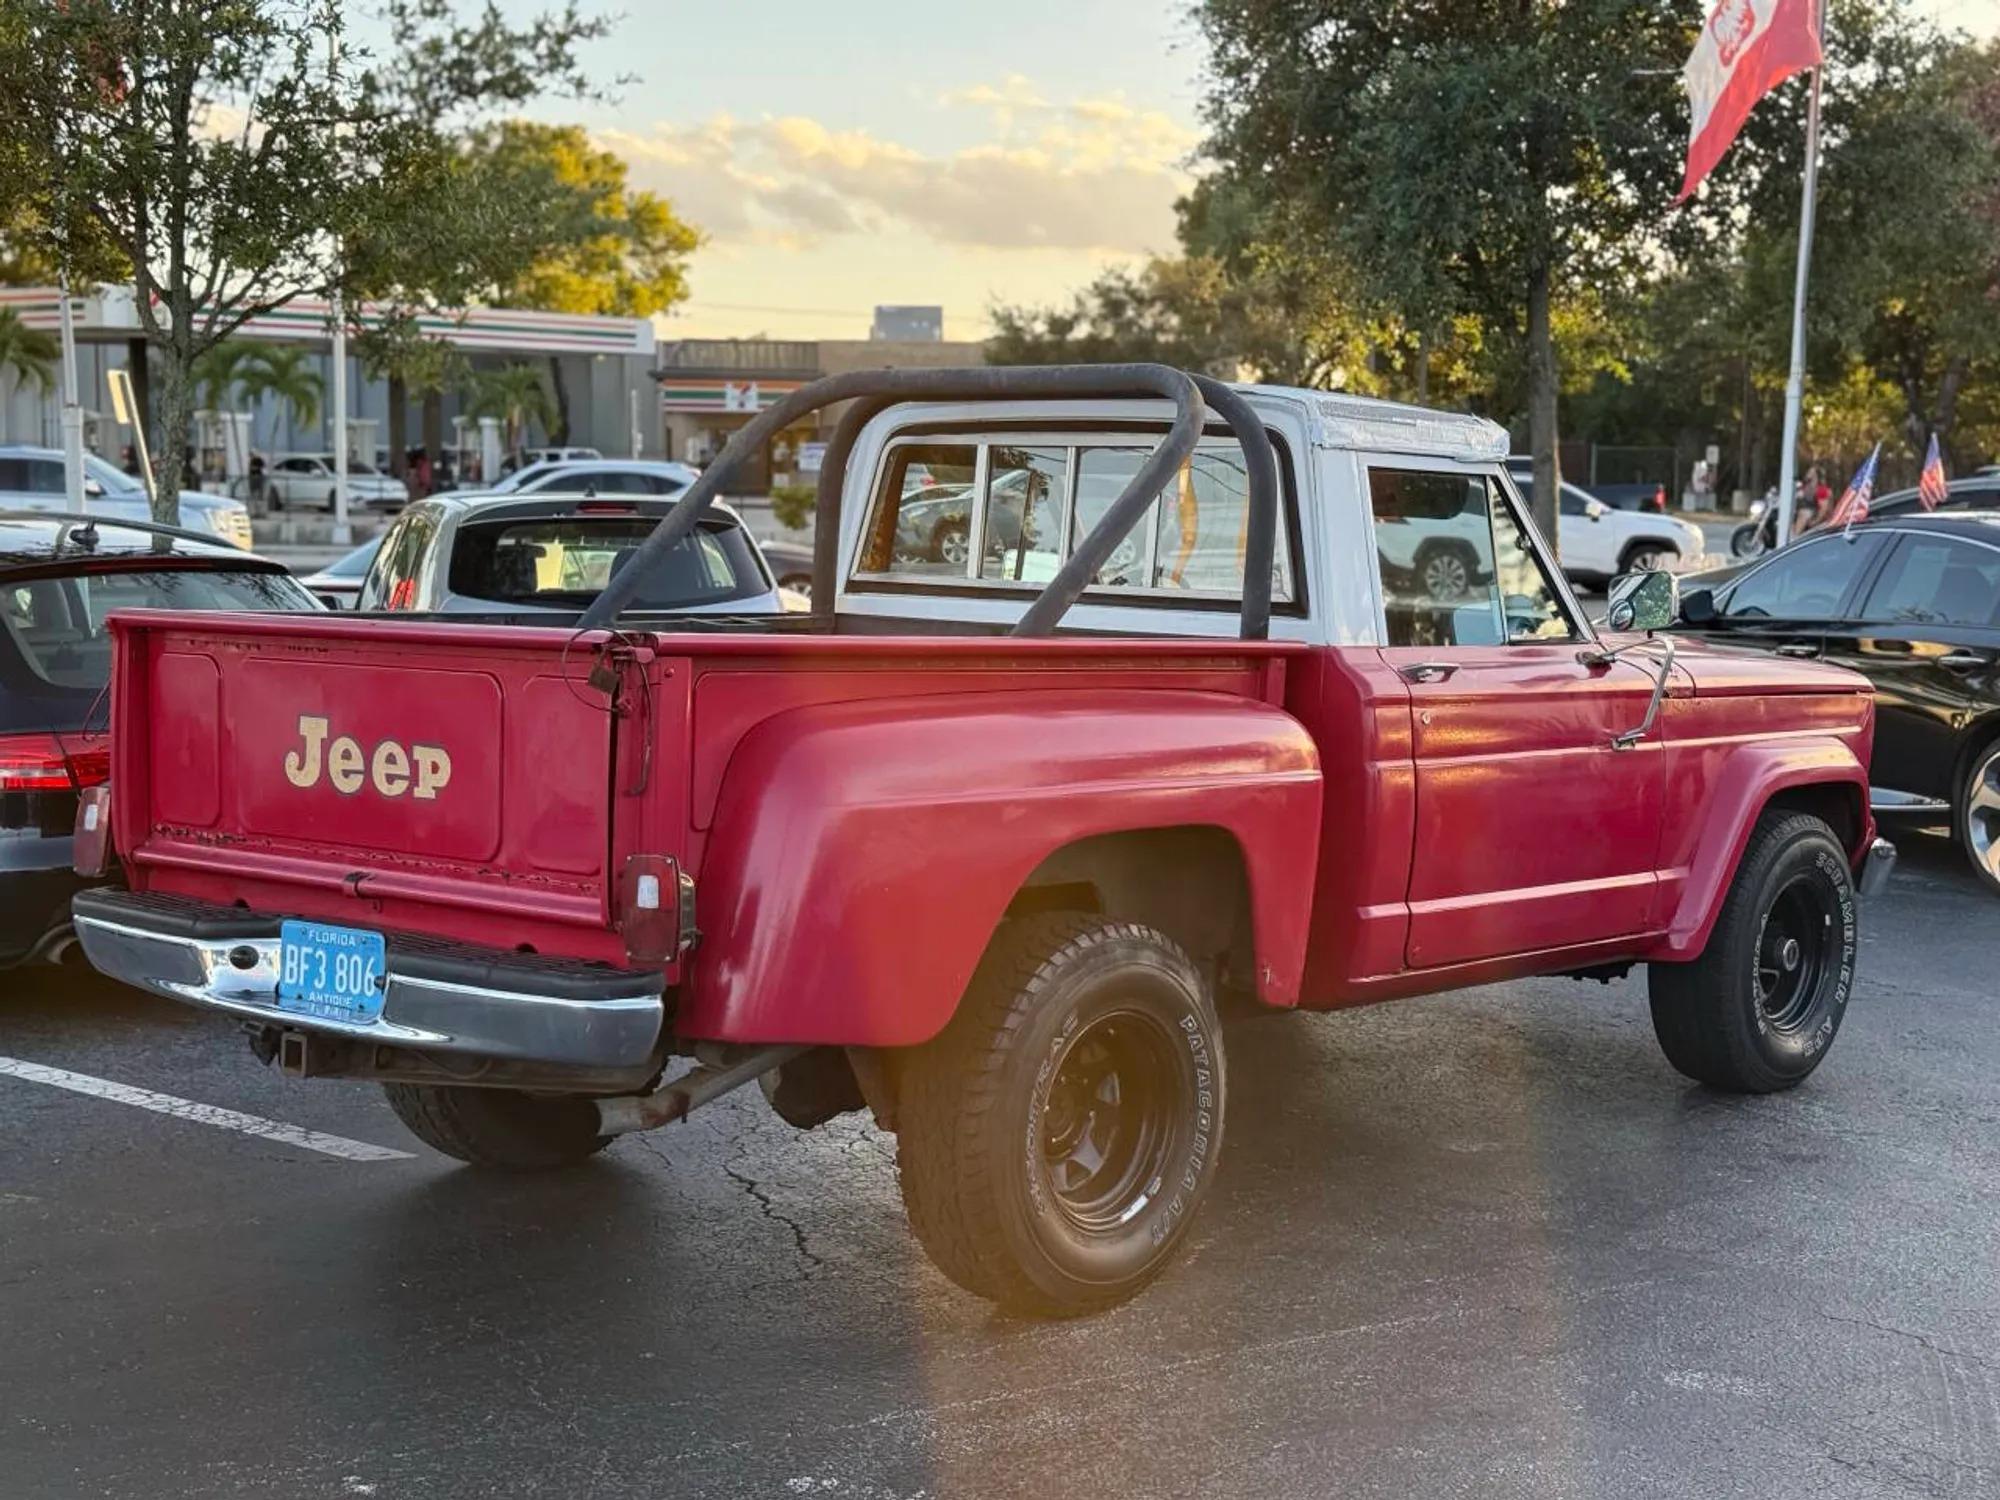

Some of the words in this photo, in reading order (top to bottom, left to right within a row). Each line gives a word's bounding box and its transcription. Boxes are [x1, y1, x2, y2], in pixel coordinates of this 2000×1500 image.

[284, 715, 451, 799] Jeep
[308, 929, 356, 946] FLORIDA
[284, 944, 327, 989] BF3
[335, 953, 376, 997] 806
[308, 992, 353, 1006] ANTIQUE
[1180, 1014, 1213, 1191] PATAGONIA
